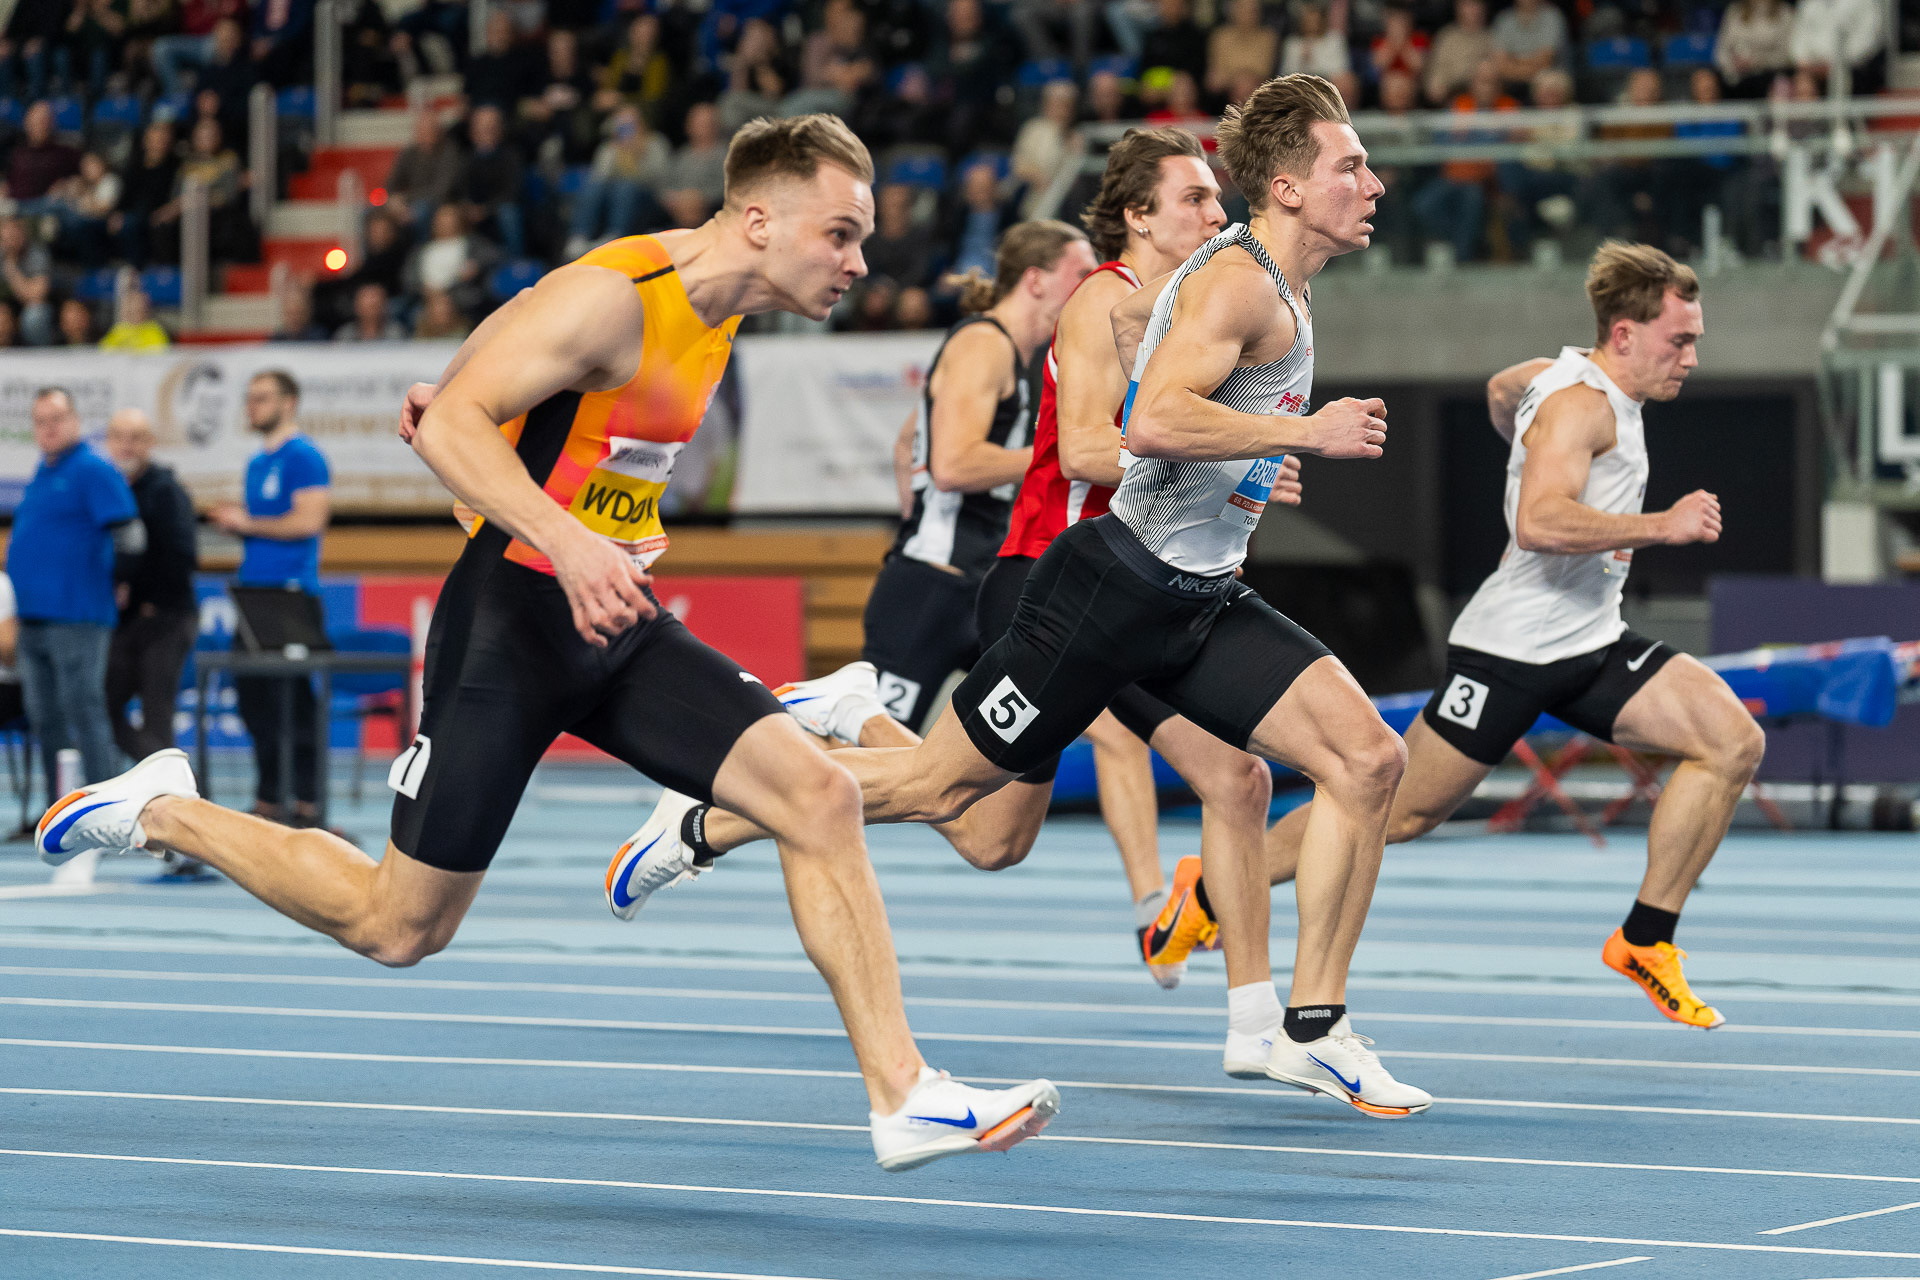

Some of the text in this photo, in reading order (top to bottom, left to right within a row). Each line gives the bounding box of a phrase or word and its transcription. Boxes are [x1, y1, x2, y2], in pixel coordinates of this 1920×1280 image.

[884, 683, 907, 712] 2
[989, 690, 1028, 730] 5
[1450, 683, 1475, 718] 3
[1624, 953, 1680, 1012] NITRO
[1297, 1008, 1332, 1020] PUMA
